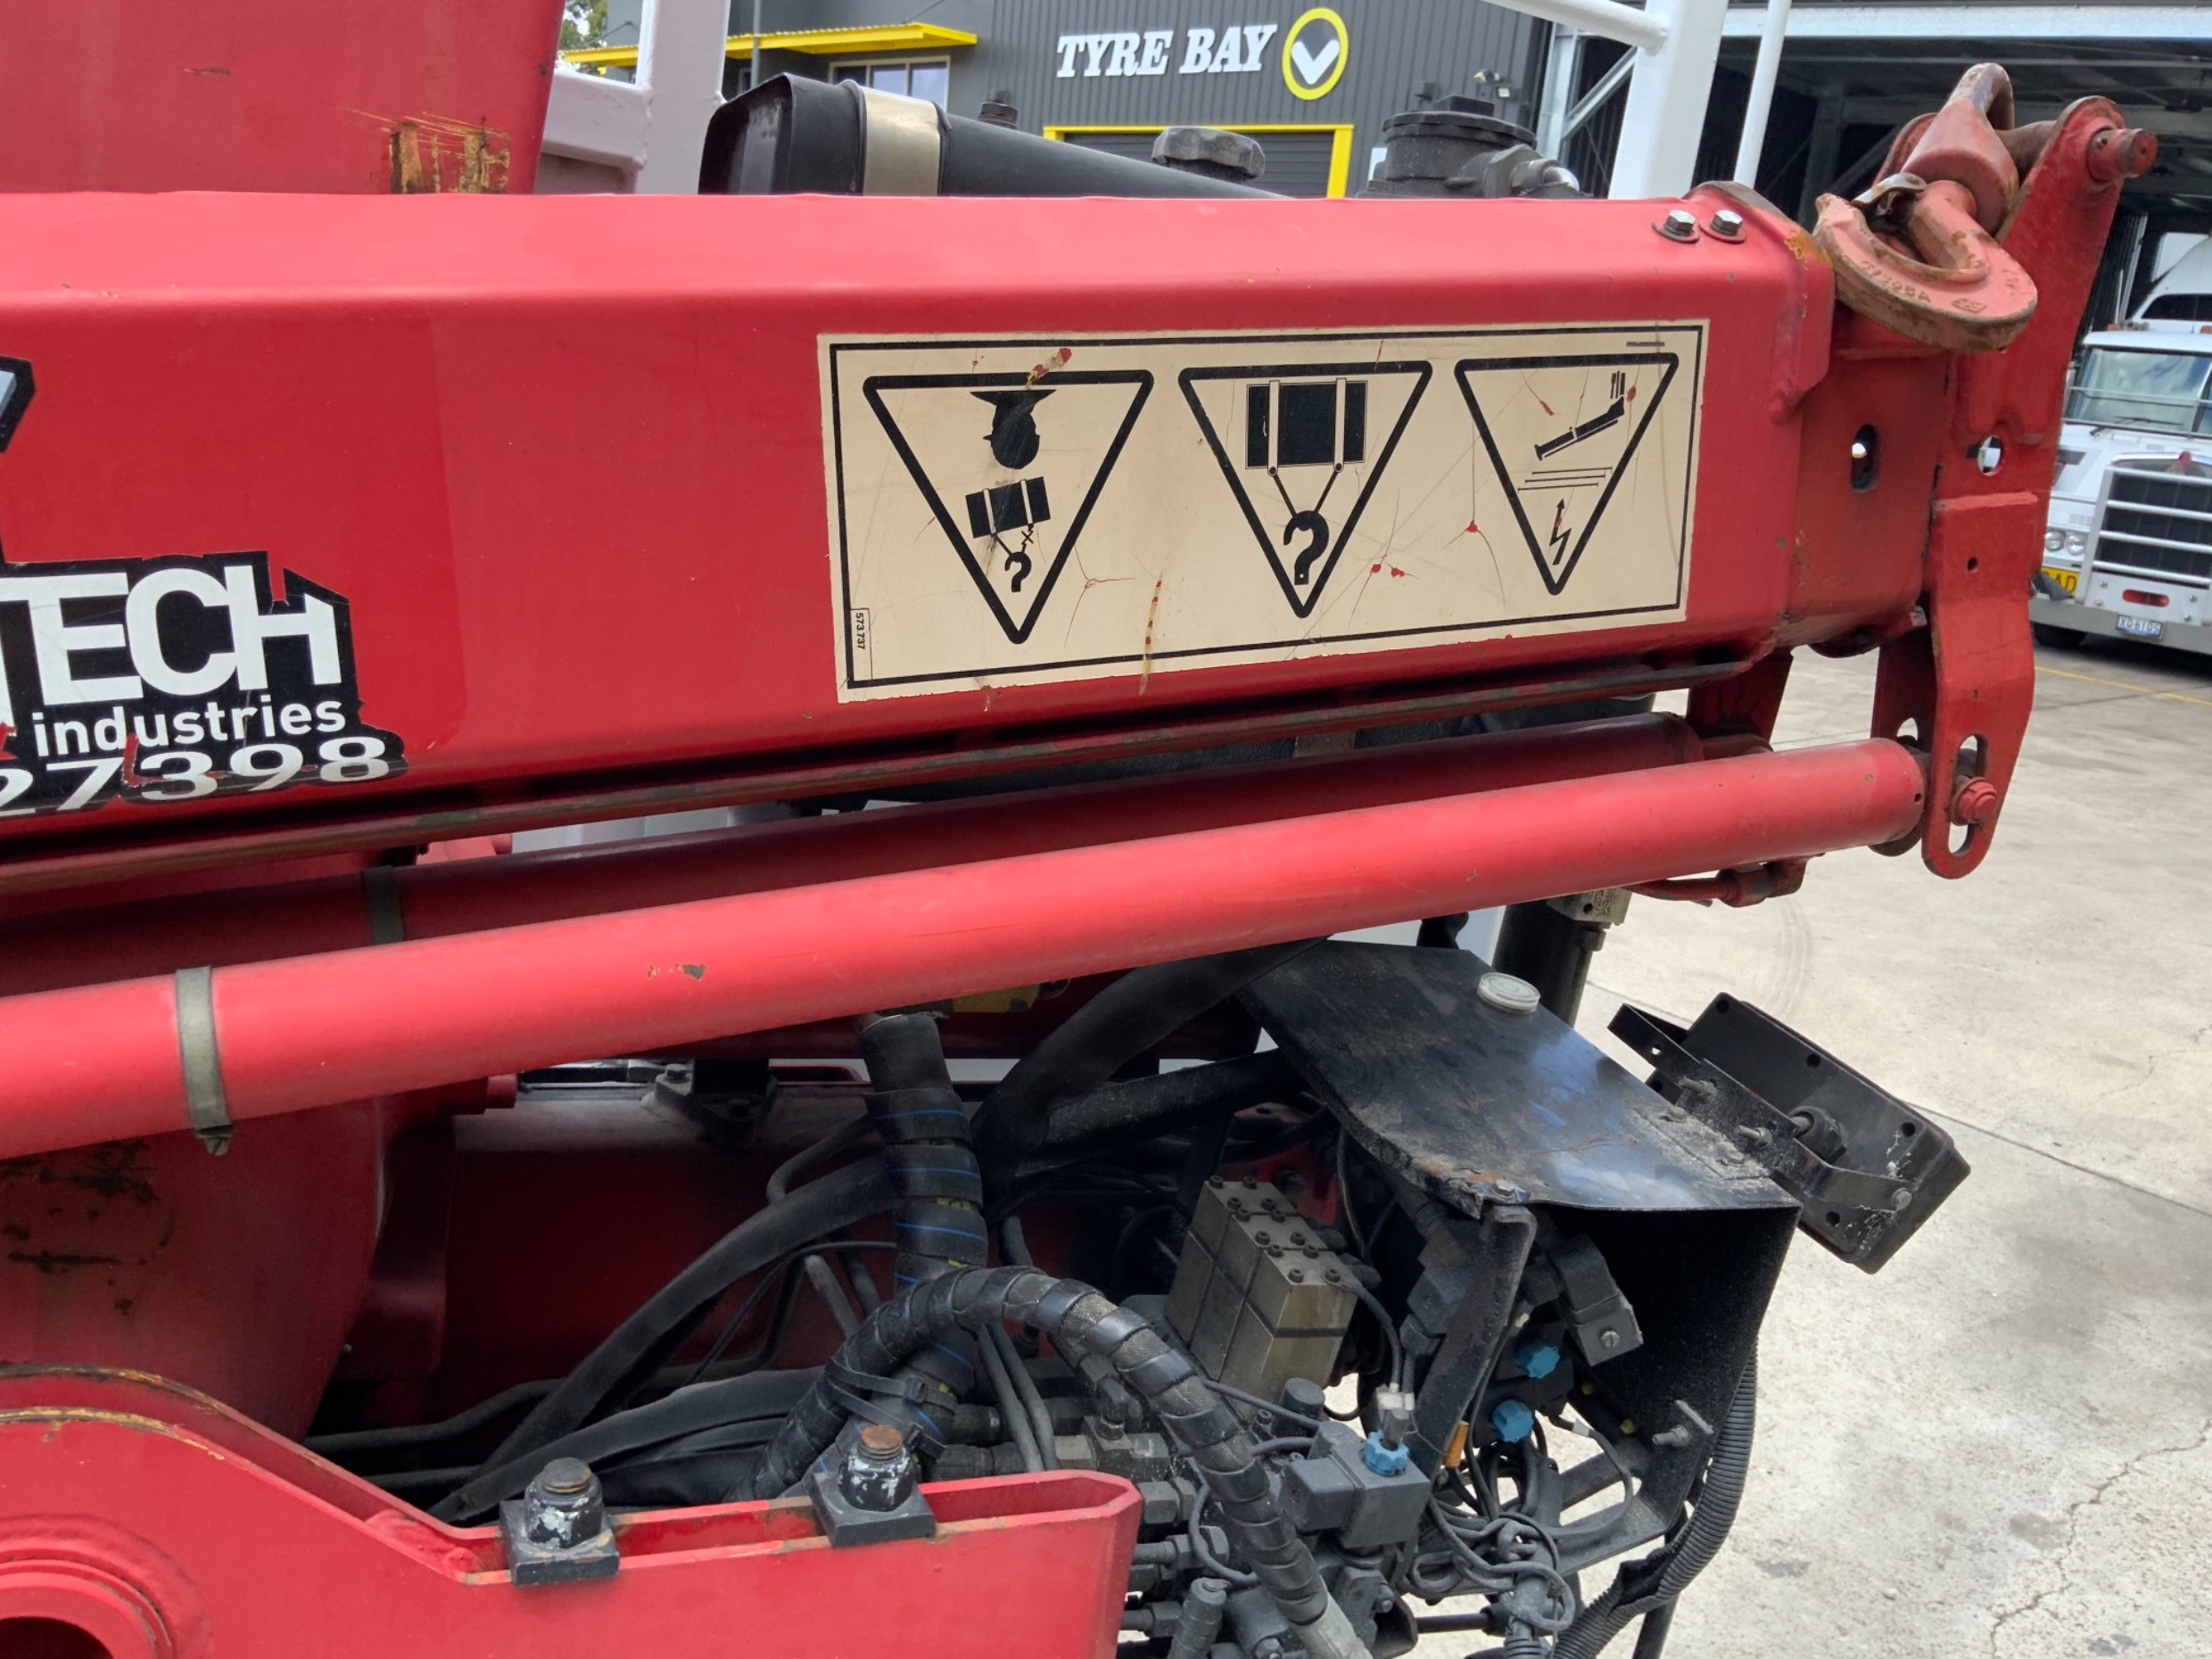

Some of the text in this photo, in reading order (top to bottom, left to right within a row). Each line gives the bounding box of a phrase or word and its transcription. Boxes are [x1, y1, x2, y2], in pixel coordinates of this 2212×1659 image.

[1056, 24, 1278, 78] TYRE BAY
[32, 696, 346, 756] industries
